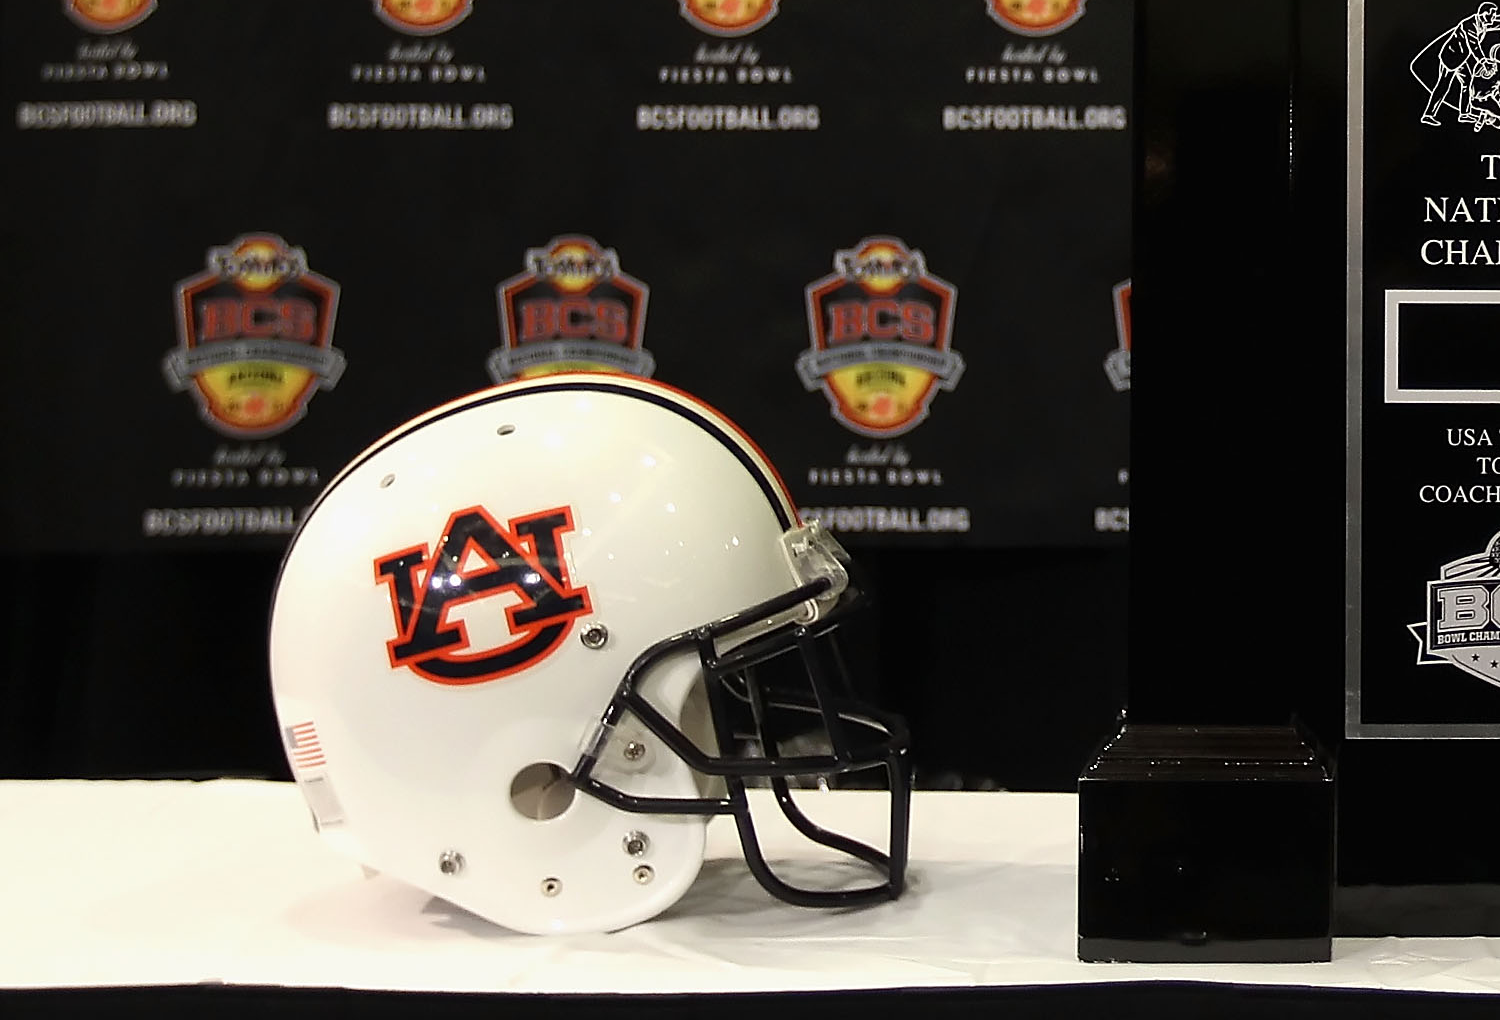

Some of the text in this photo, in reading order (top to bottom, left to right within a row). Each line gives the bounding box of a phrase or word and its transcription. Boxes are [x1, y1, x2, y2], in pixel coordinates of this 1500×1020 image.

[521, 298, 629, 342] BCS
[831, 298, 935, 342] BCS
[1446, 428, 1493, 446] USA
[1437, 632, 1467, 645] BOWL
